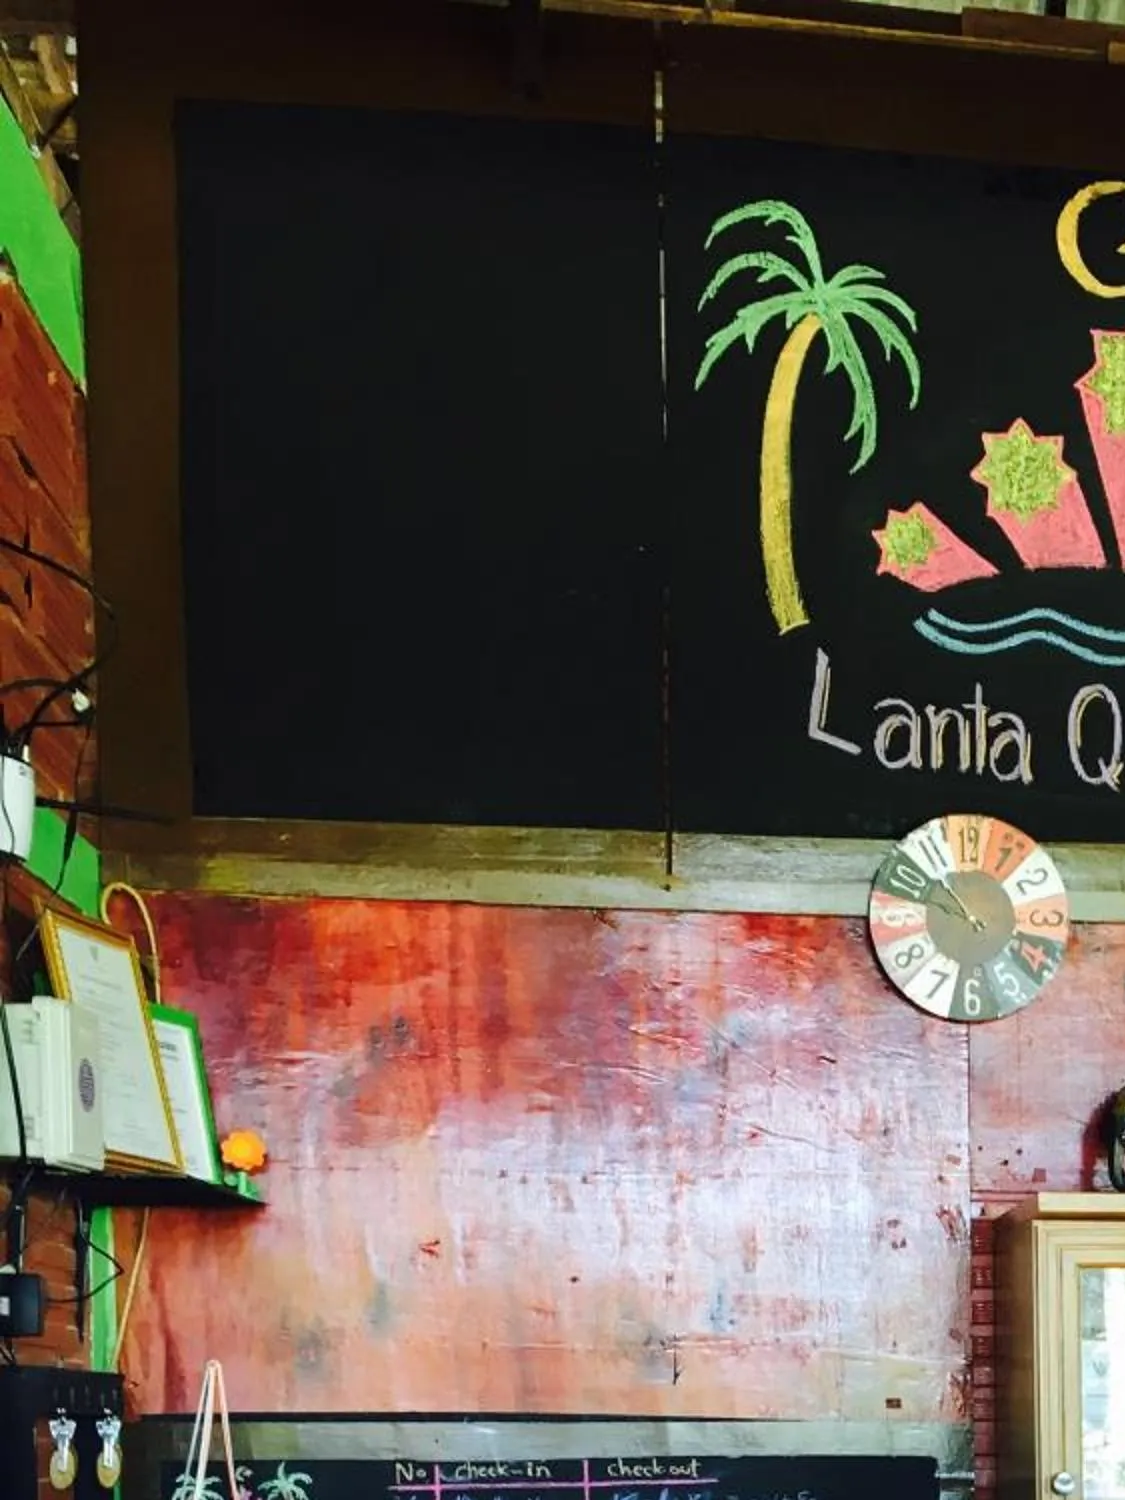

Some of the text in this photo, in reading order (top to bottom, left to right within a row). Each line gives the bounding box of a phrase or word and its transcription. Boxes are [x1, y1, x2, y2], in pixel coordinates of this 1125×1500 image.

[808, 648, 1034, 785] Lanta
[917, 834, 948, 871] 11
[957, 825, 980, 865] 12
[889, 864, 926, 899] 10
[1015, 866, 1050, 896] 2
[1029, 909, 1065, 928] 3
[894, 942, 924, 970] 8
[926, 969, 951, 1000] 7
[992, 960, 1021, 998] 5
[963, 979, 981, 1016] 6
